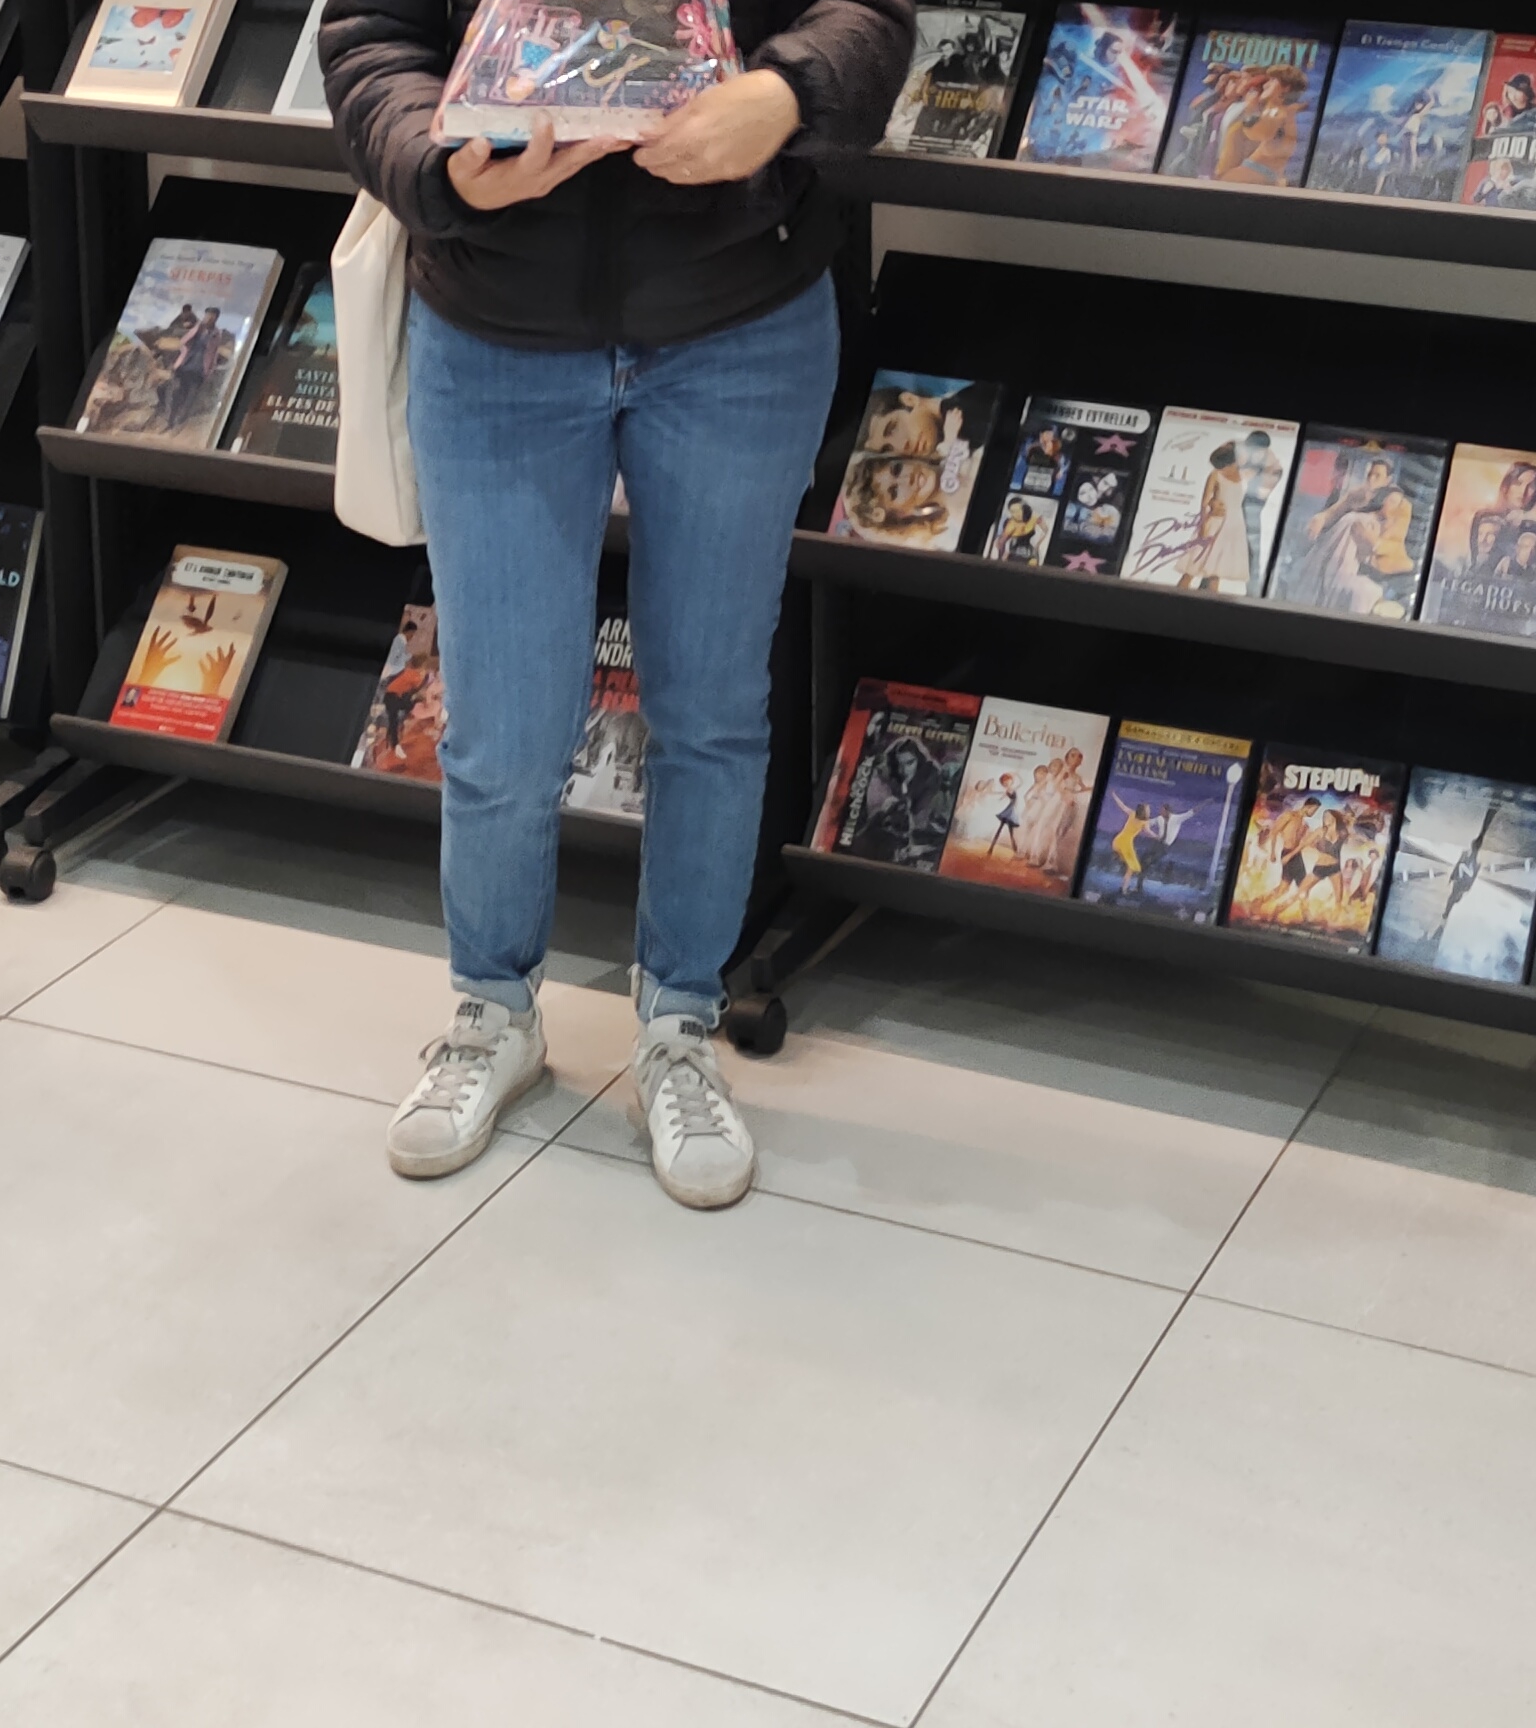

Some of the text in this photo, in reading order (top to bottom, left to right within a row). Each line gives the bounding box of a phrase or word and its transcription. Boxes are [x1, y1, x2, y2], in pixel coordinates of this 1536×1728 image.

[1068, 95, 1129, 113] STAR
[1066, 111, 1128, 129] WARS
[1489, 136, 1529, 159] JOJO
[296, 383, 335, 399] MOYA
[267, 394, 282, 408] EL
[314, 400, 336, 413] DE
[1085, 409, 1140, 428] ESTRELLAS
[1440, 577, 1513, 598] LEGADO
[983, 715, 1075, 750] Ballerina
